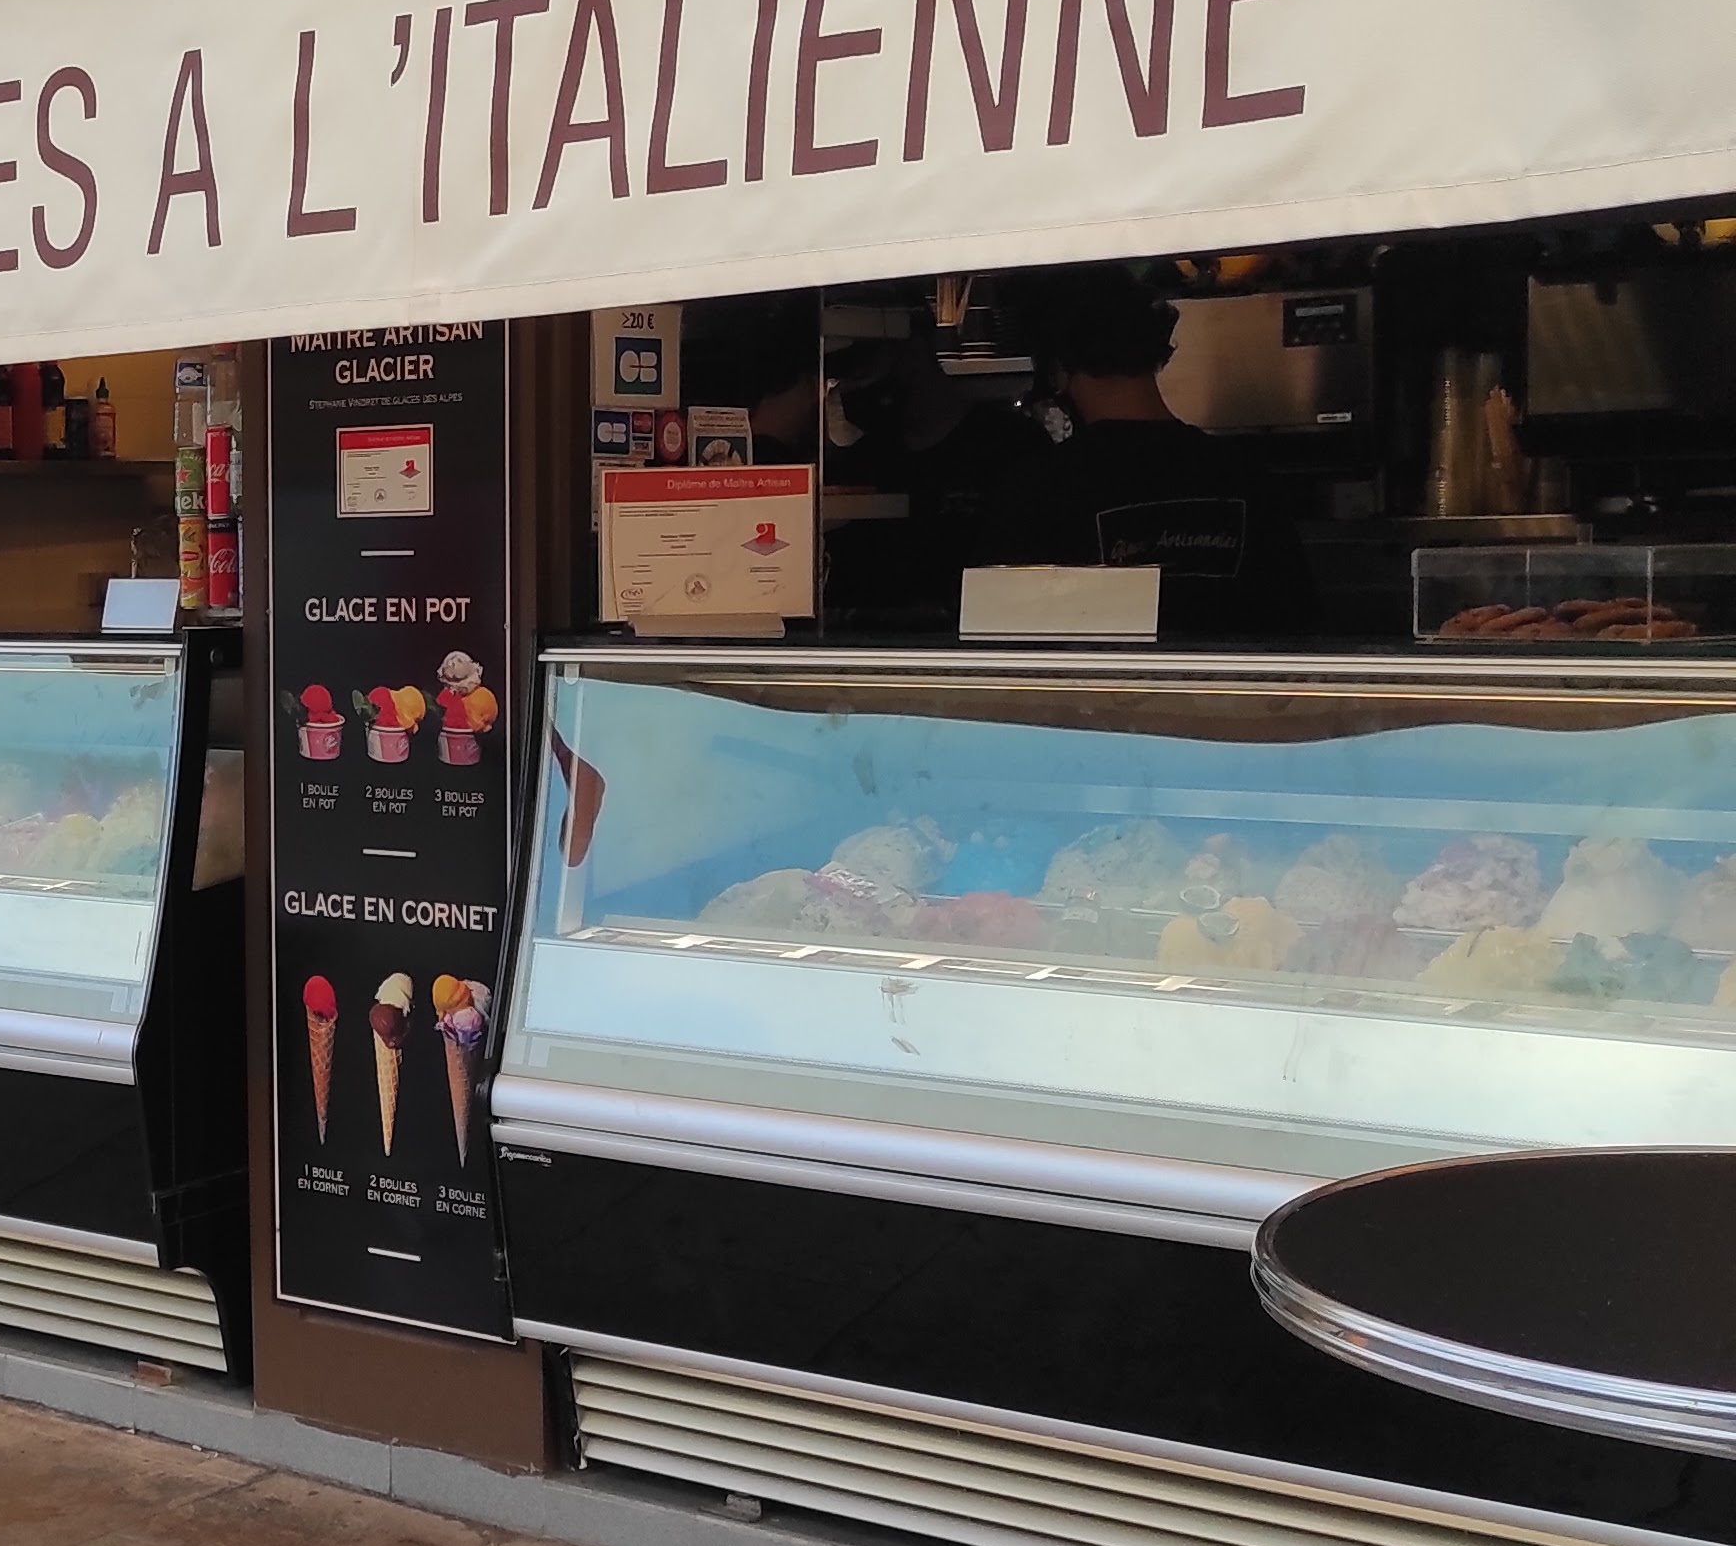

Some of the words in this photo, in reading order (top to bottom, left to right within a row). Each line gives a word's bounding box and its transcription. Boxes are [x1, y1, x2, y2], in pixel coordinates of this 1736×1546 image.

[146, 49, 222, 256] A
[383, 321, 483, 346] ARTISAN
[335, 355, 434, 384] GLACIER
[305, 597, 377, 622] GLACE
[385, 597, 416, 622] EN
[426, 597, 470, 623] POT
[307, 784, 339, 796] BOULE
[365, 785, 373, 798] 2
[375, 787, 414, 800] BOULES
[434, 788, 442, 802] 3
[444, 790, 485, 804] BOULES
[302, 797, 316, 809] EN
[318, 798, 337, 810] POT
[372, 801, 386, 813] EN
[388, 802, 407, 814] POT
[442, 805, 456, 817] EN
[458, 806, 478, 818] POT
[284, 890, 357, 920] GLACE
[363, 896, 395, 924] EN
[401, 900, 499, 932] CORNET
[312, 1166, 344, 1182] BOULE
[298, 1177, 311, 1190] EN
[312, 1179, 351, 1197] CORNET
[369, 1174, 377, 1188] 2
[379, 1177, 418, 1194] BOULES
[438, 1185, 446, 1199] 3
[367, 1189, 381, 1203] EN
[382, 1191, 422, 1208] CORNET
[436, 1200, 450, 1214] EN
